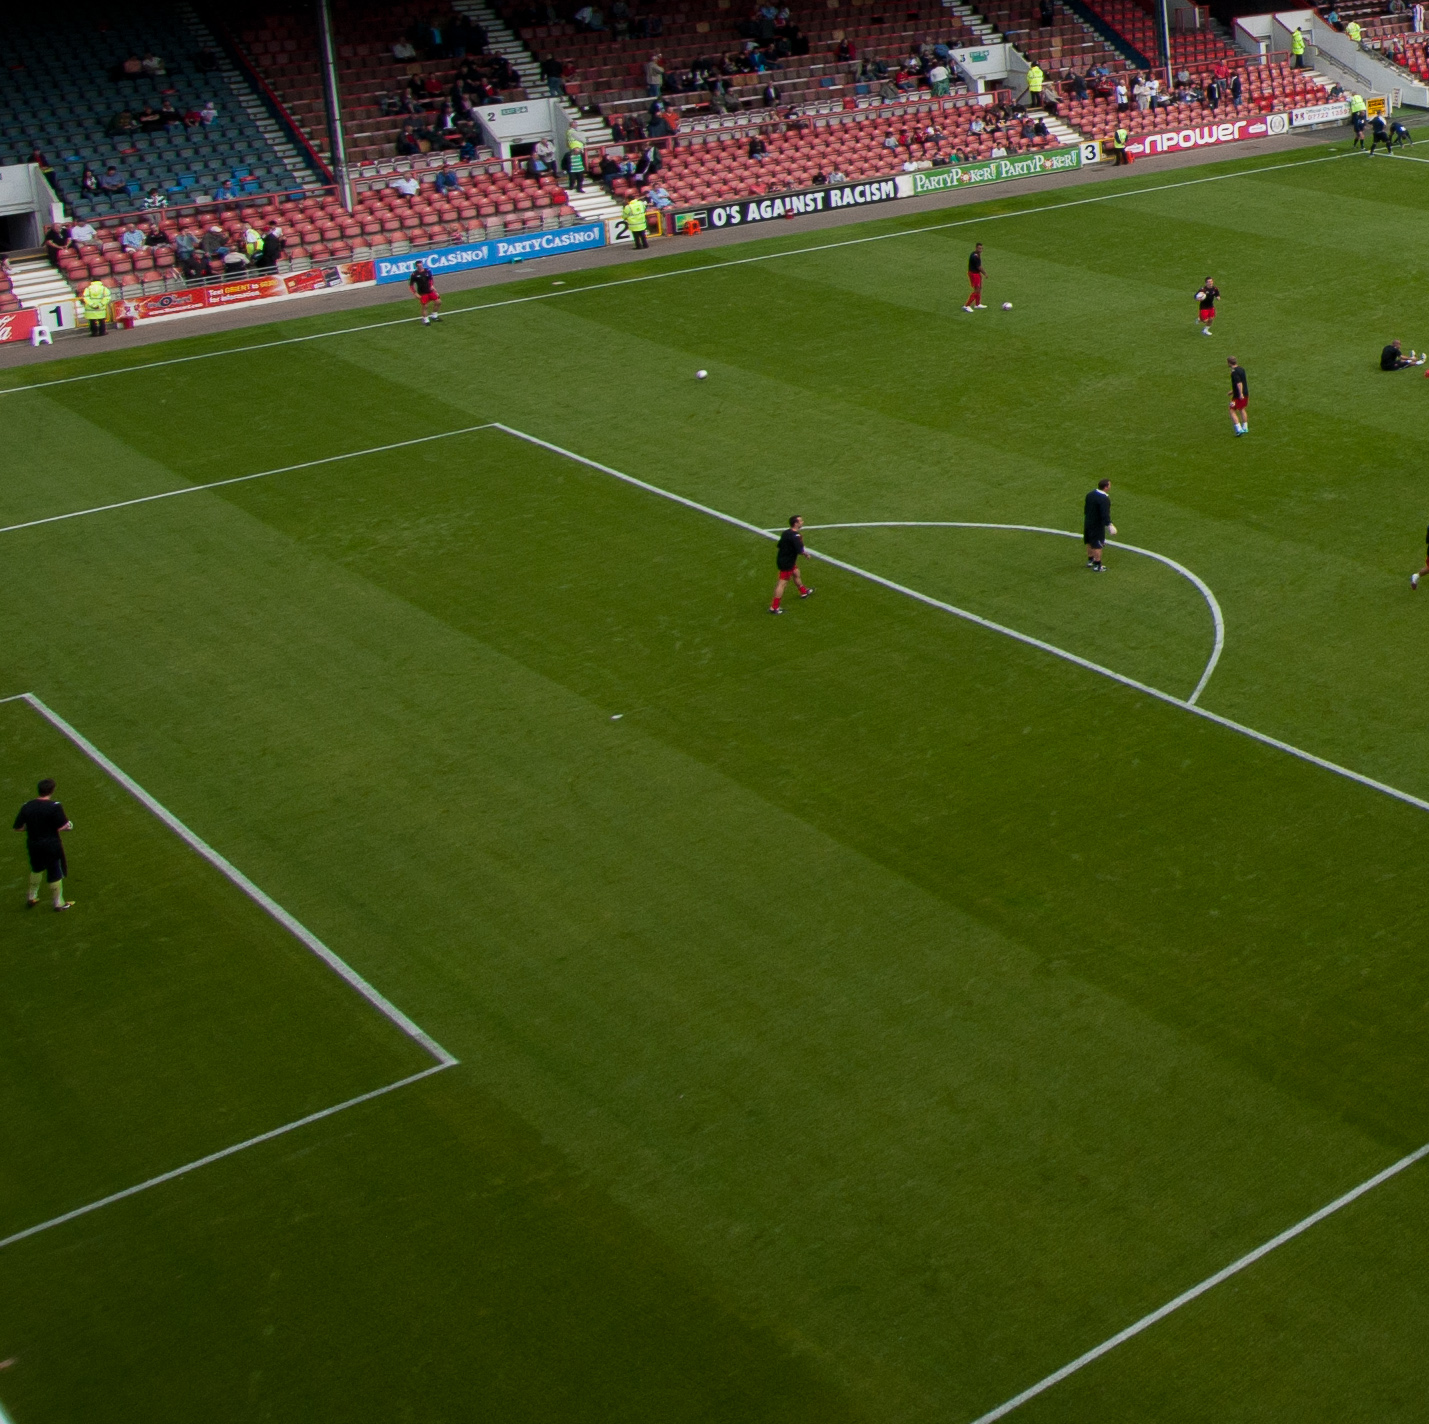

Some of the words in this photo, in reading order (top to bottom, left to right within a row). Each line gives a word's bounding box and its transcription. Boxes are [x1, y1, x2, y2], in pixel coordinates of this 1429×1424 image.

[959, 53, 966, 63] 3
[487, 112, 496, 121] 2
[1084, 144, 1097, 161] 3
[712, 206, 741, 227] O'S
[747, 192, 824, 222] AGAINST
[830, 180, 895, 209] RACISM
[614, 220, 631, 240] 2
[48, 305, 64, 327] 1
